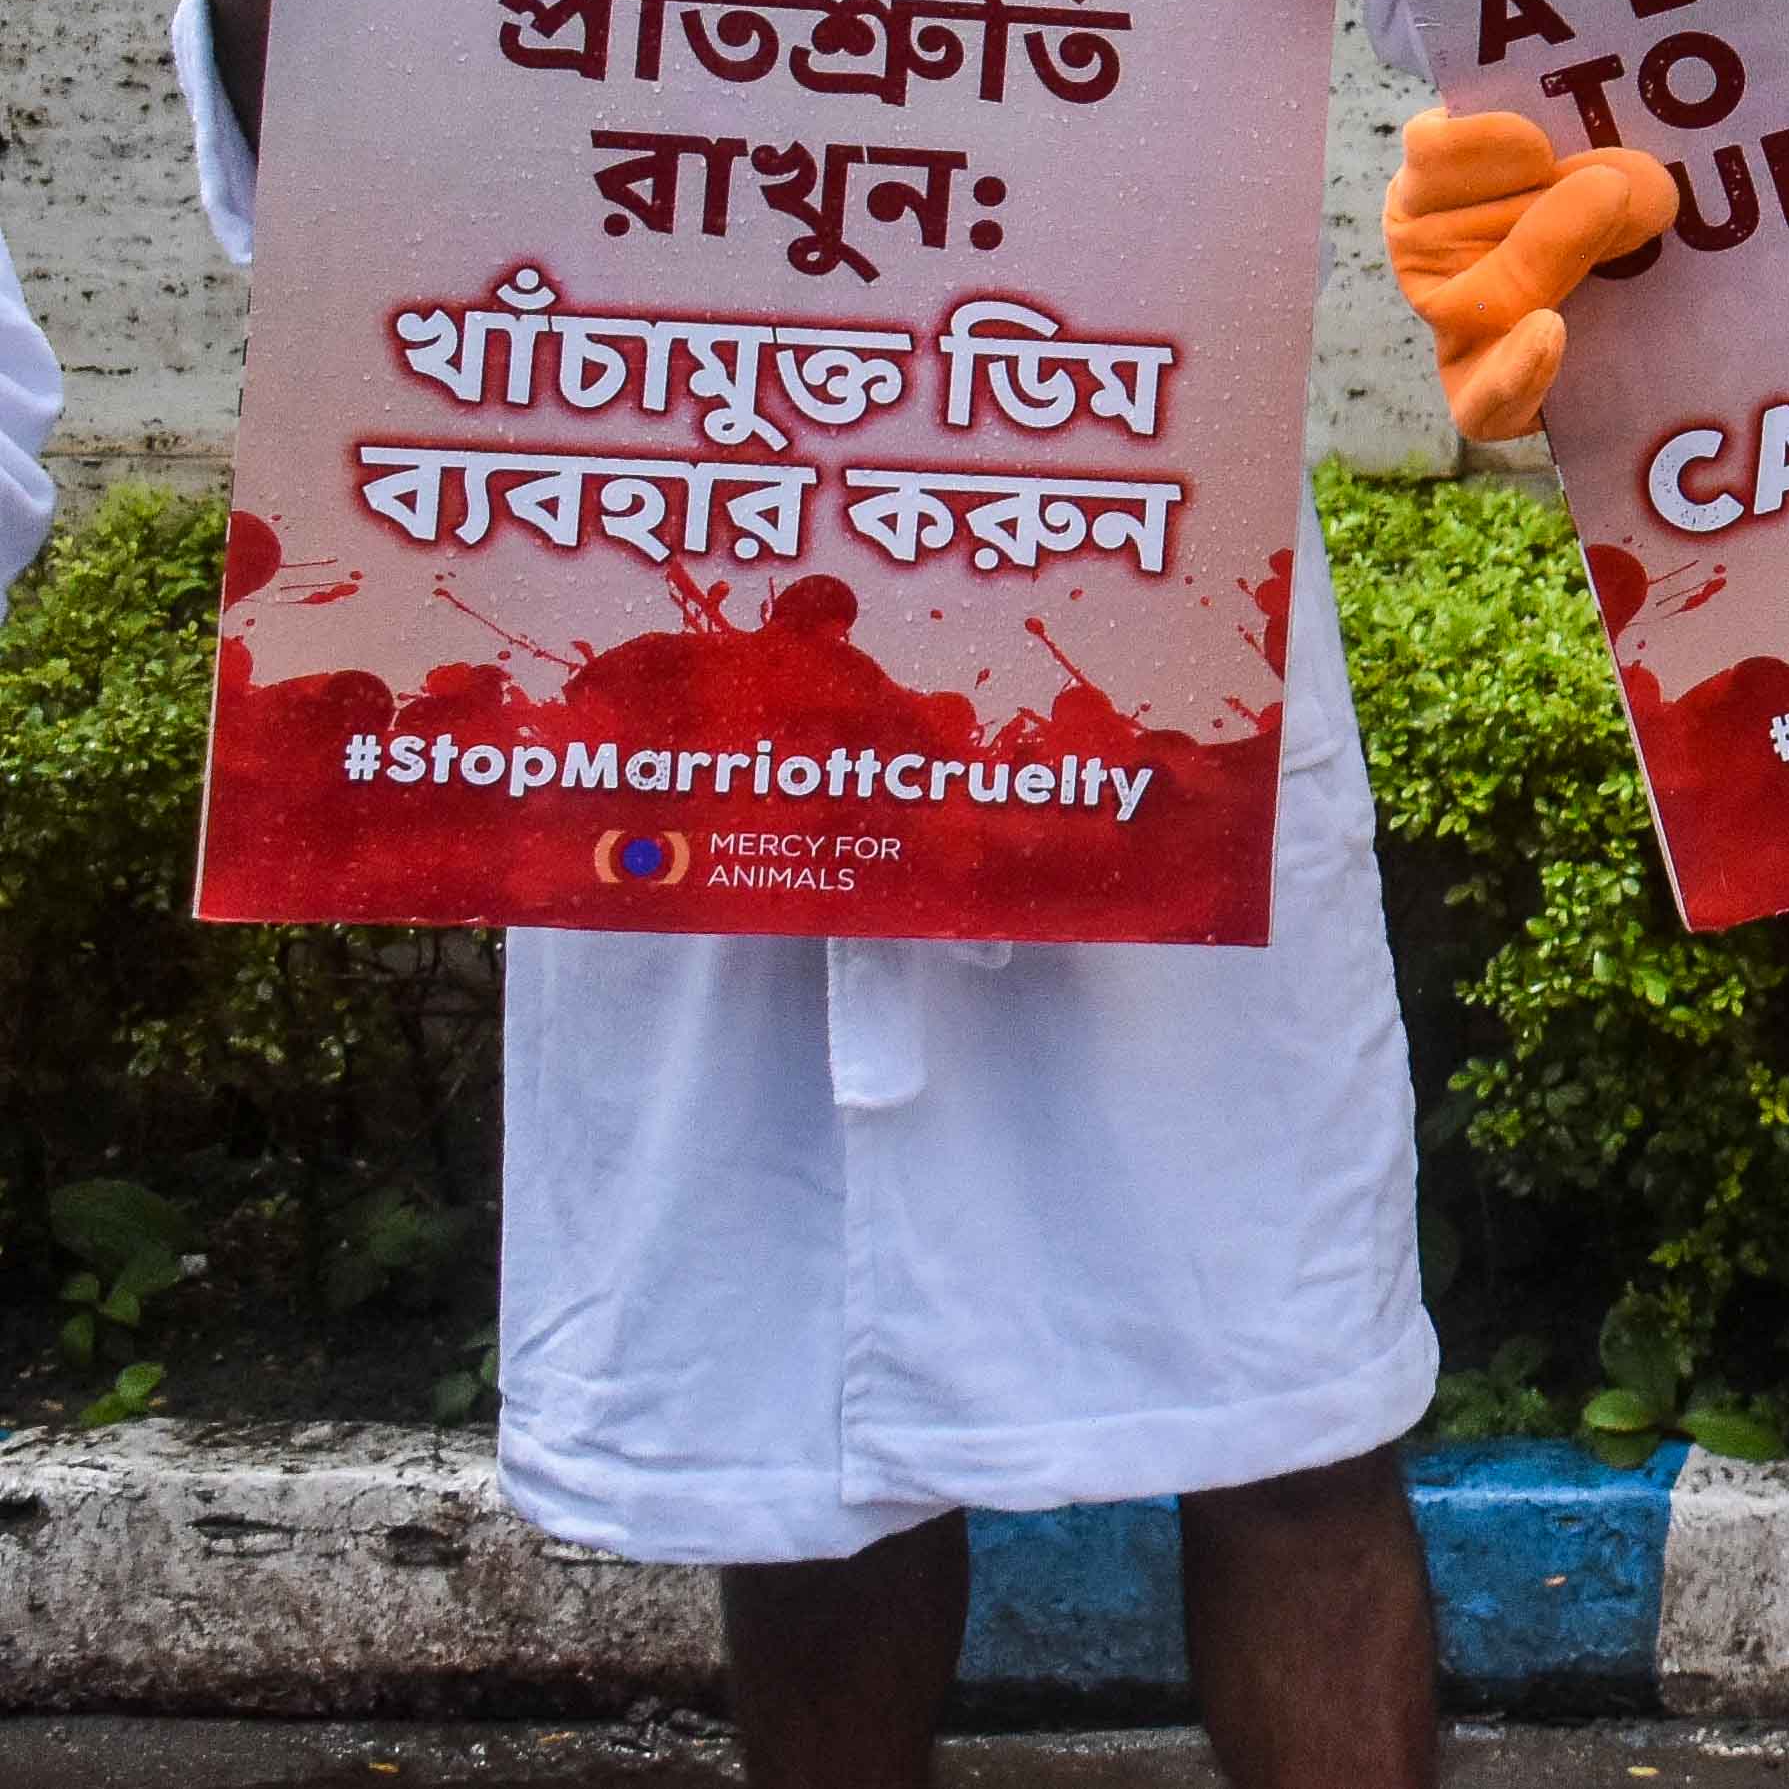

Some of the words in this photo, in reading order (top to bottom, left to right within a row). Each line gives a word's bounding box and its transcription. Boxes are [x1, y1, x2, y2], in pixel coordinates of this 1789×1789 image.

[1540, 31, 1746, 149] TO
[397, 267, 912, 451] খাঁচামুক্ত
[940, 300, 1173, 435] ডিম
[360, 447, 817, 561] ব্যবহার
[846, 470, 1181, 574] করুন
[344, 733, 1152, 821] #StopMarriottCruelty
[707, 864, 855, 892] ANIMALS
[710, 832, 825, 857] MERCY
[834, 836, 901, 860] FOR
